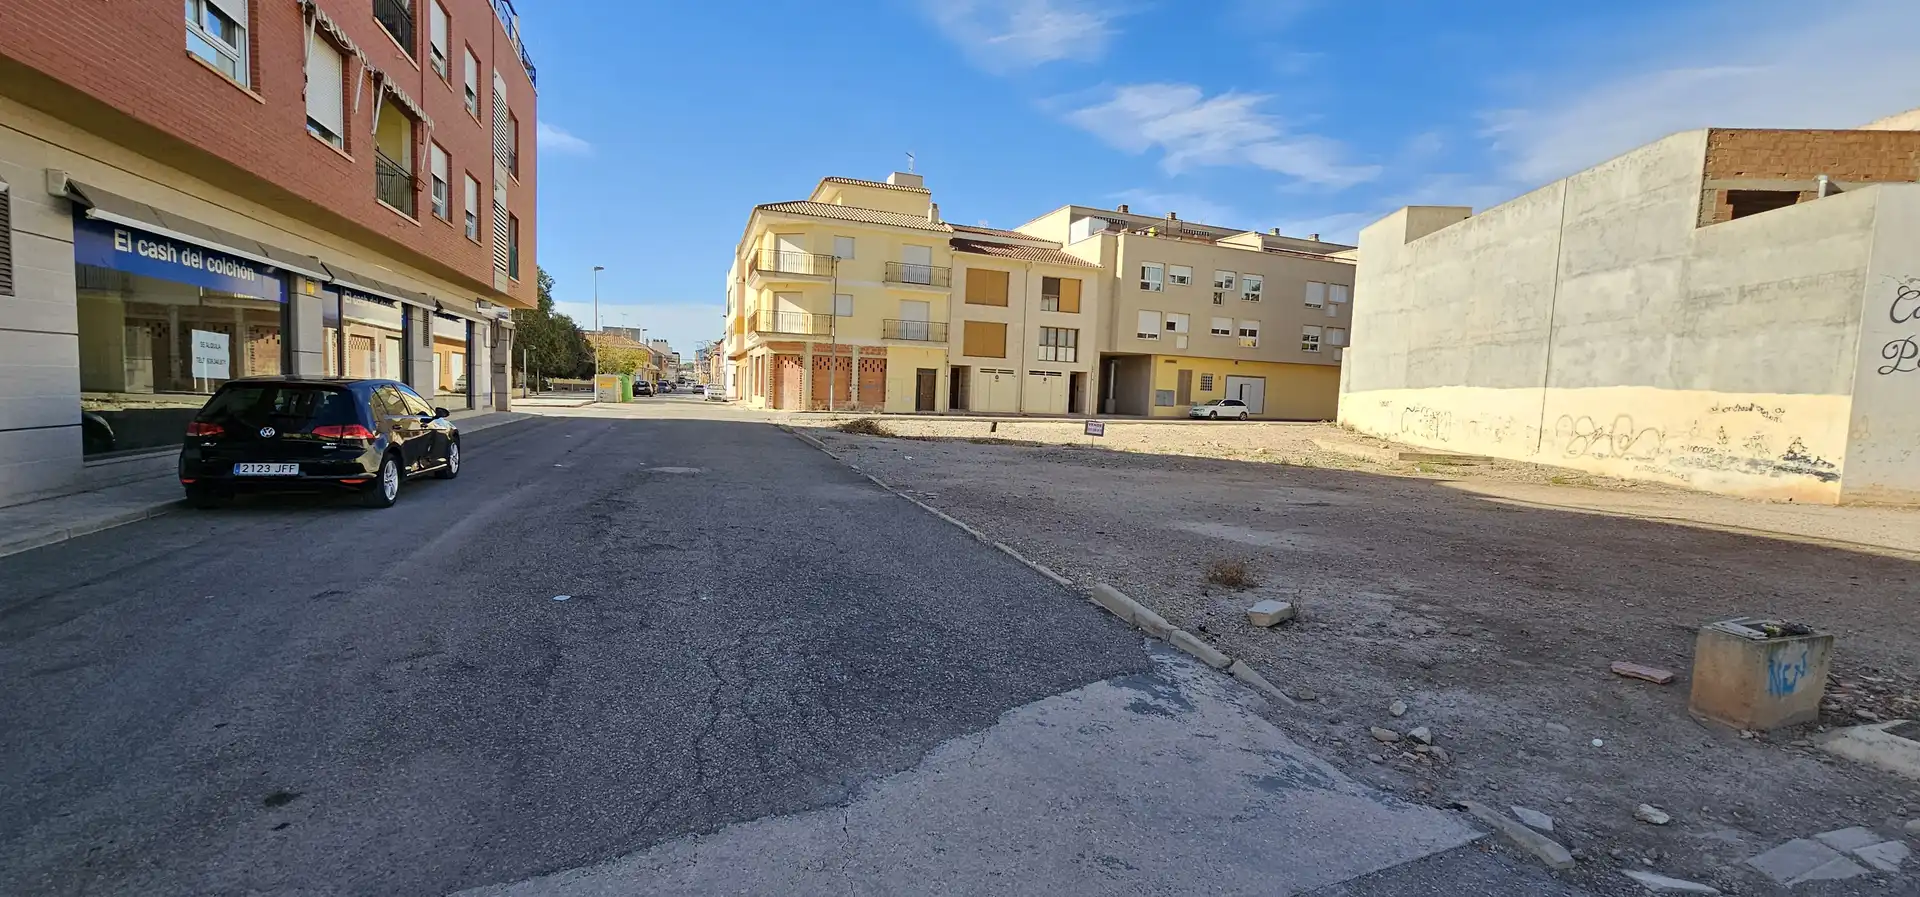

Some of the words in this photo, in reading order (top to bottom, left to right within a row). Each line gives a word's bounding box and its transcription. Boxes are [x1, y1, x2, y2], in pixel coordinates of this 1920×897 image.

[114, 229, 132, 253] El
[137, 238, 177, 264] cash
[181, 247, 203, 270] del
[207, 257, 255, 281] colchón
[1877, 334, 1920, 375] P
[242, 464, 271, 473] 2123
[275, 464, 296, 473] JFF
